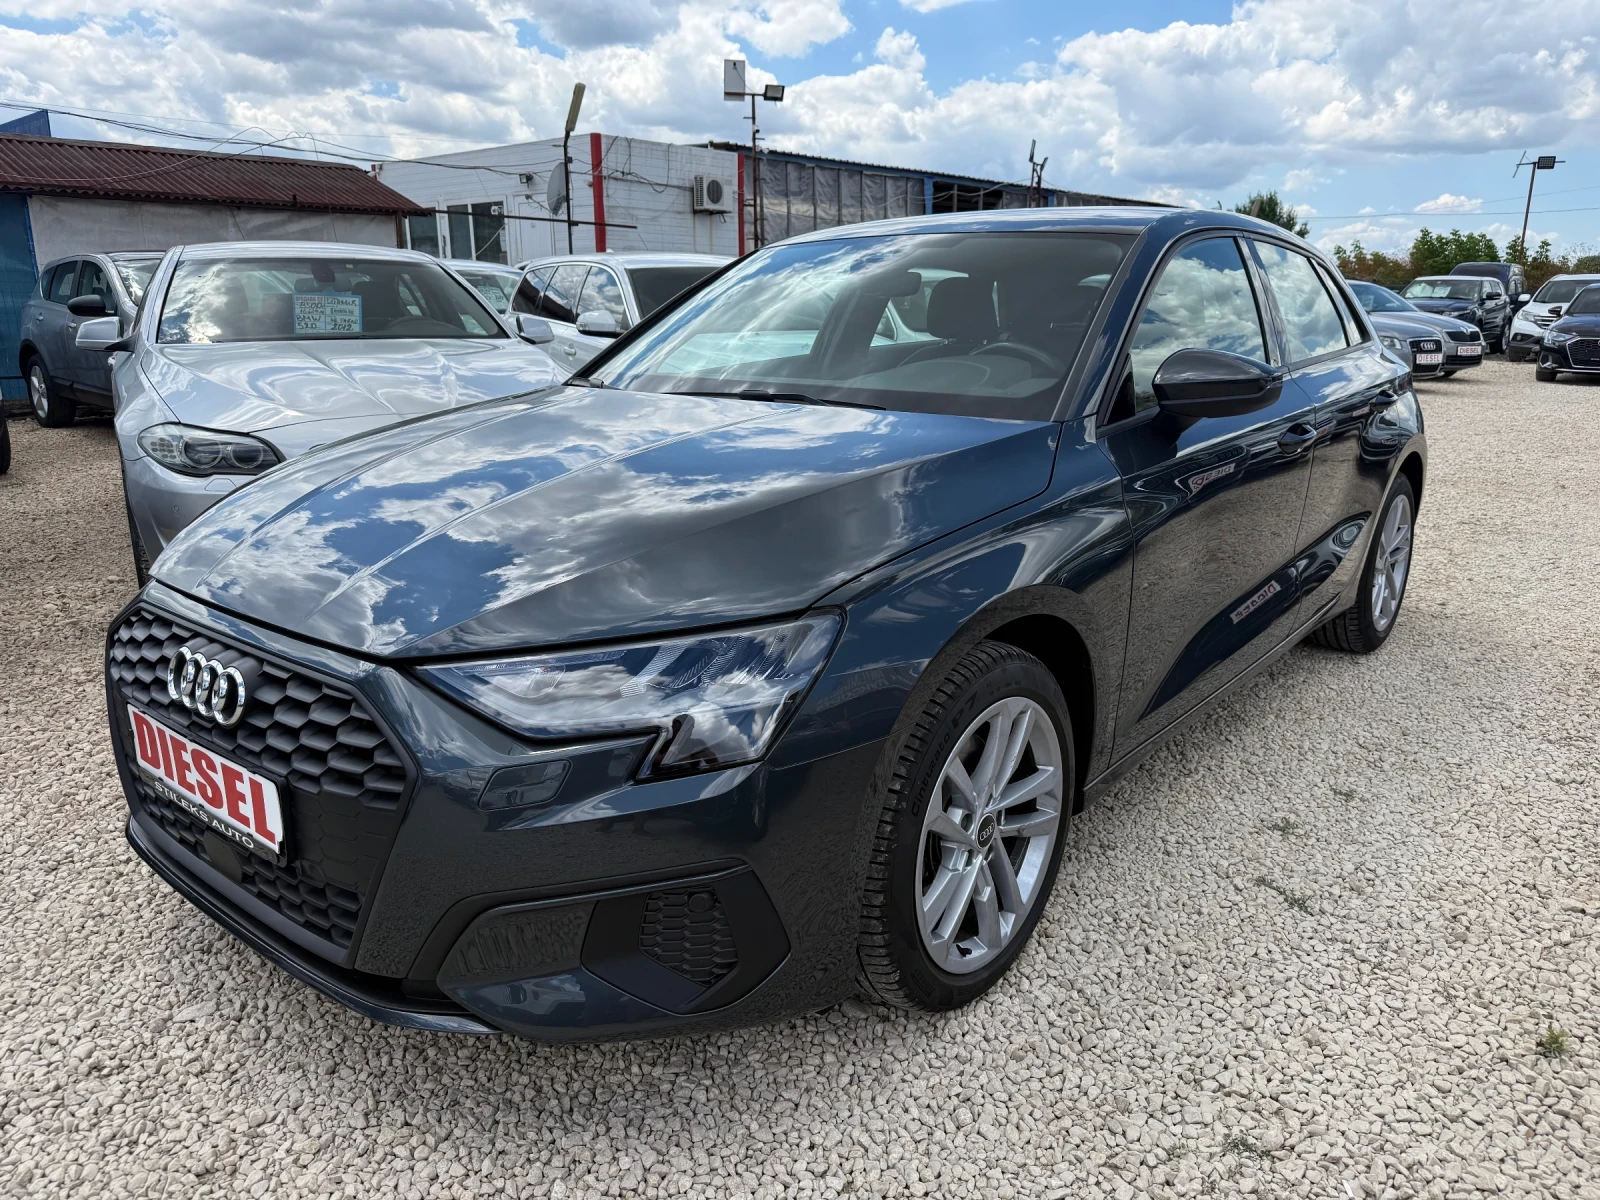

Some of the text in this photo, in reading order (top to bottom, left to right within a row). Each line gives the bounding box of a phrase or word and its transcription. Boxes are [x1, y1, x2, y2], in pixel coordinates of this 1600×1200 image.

[296, 314, 321, 322] BMW
[1417, 354, 1440, 362] DIESEL
[1459, 346, 1479, 354] DIESEL
[950, 690, 978, 730] P7
[132, 710, 277, 846] DIESEL
[154, 780, 255, 849] STILEKS AUTO
